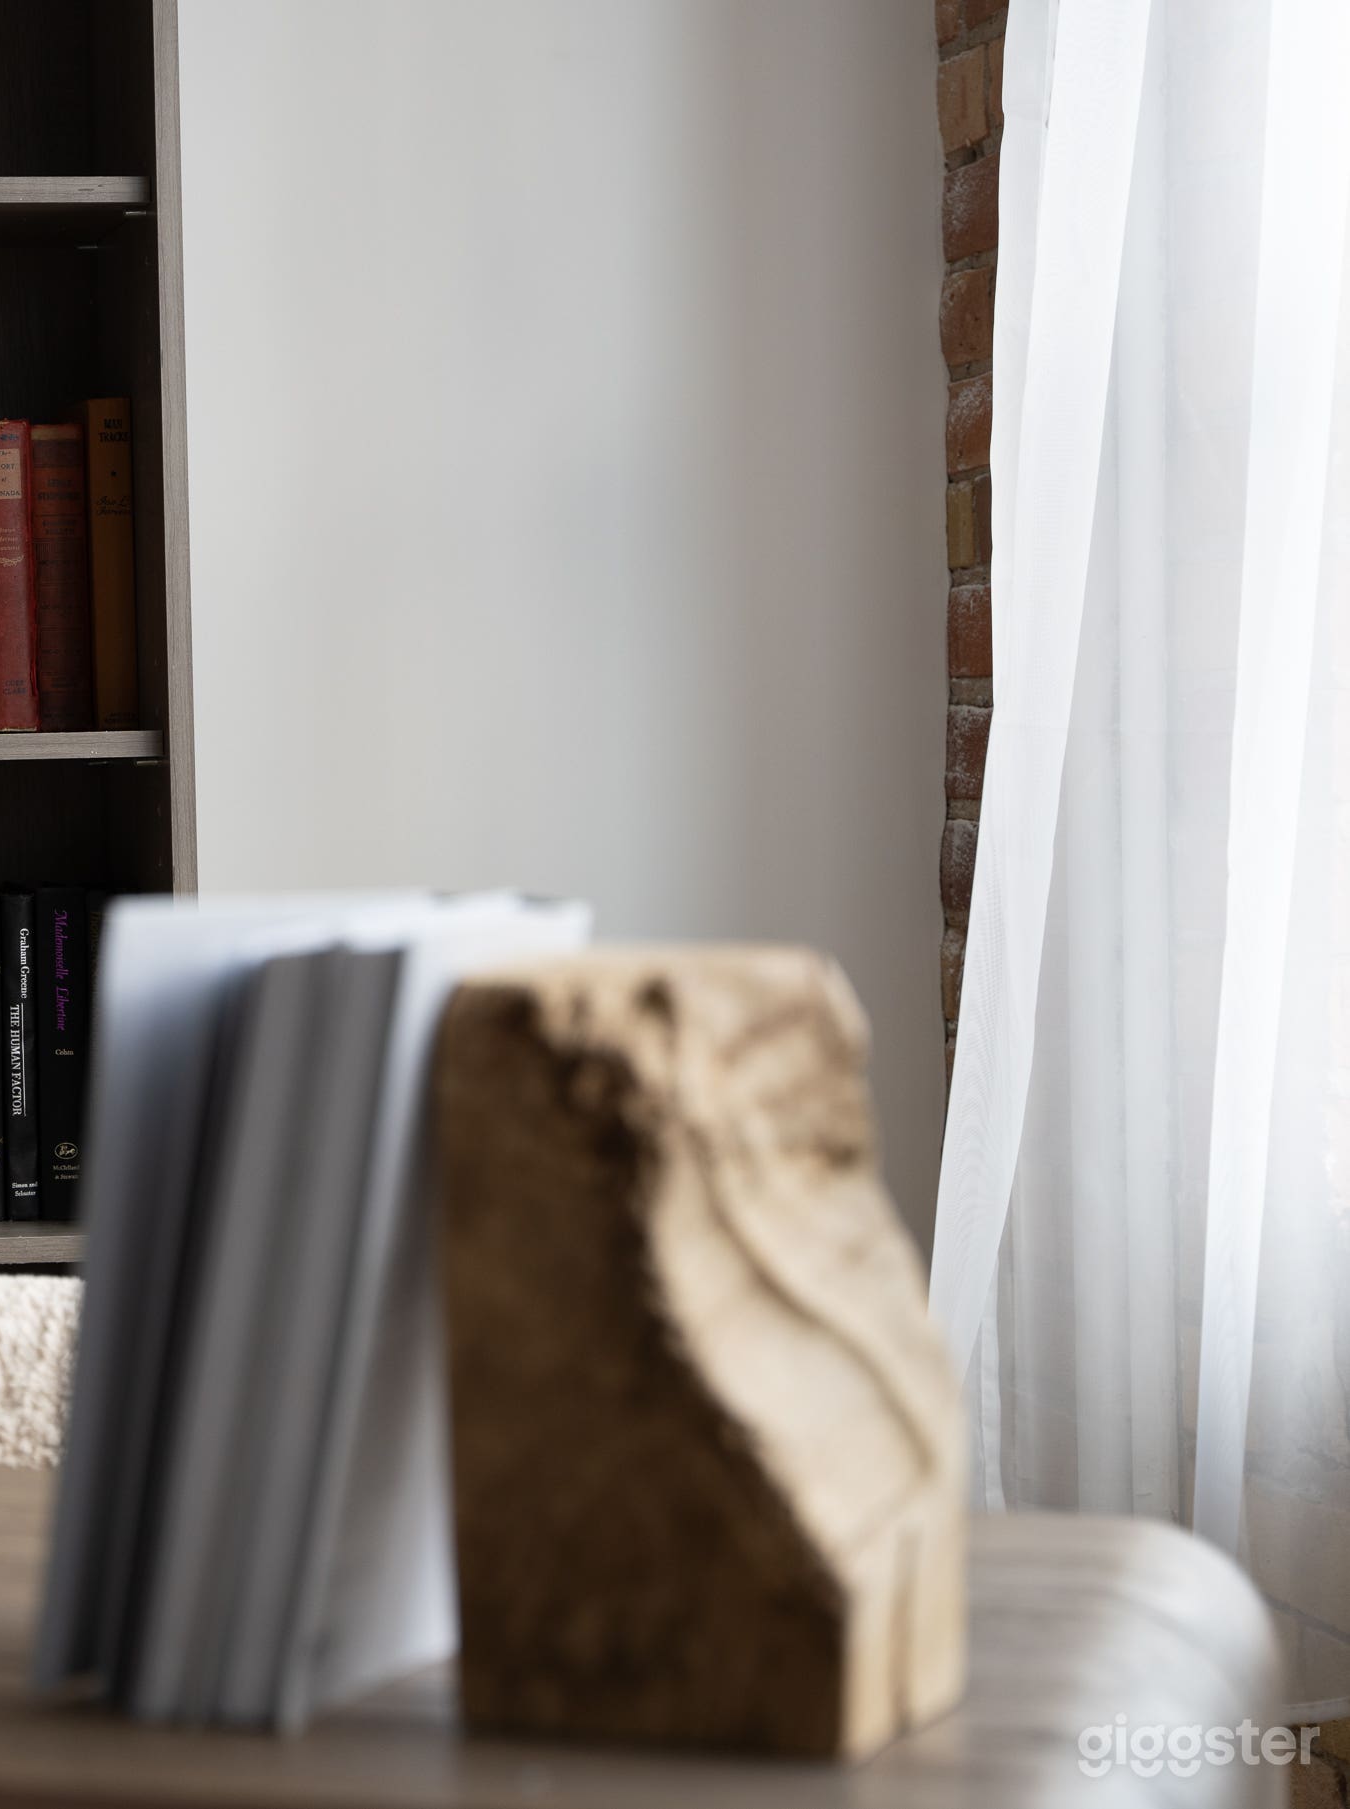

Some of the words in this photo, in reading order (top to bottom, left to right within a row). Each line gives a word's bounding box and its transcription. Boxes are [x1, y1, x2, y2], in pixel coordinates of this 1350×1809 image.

[19, 927, 30, 965] Graham
[54, 908, 70, 980] Mademoiselle
[20, 965, 30, 999] Greene
[10, 1004, 20, 1026] THE
[55, 985, 70, 1032] Libertine
[10, 1030, 21, 1070] HUMAN
[11, 1072, 23, 1117] FACTOR
